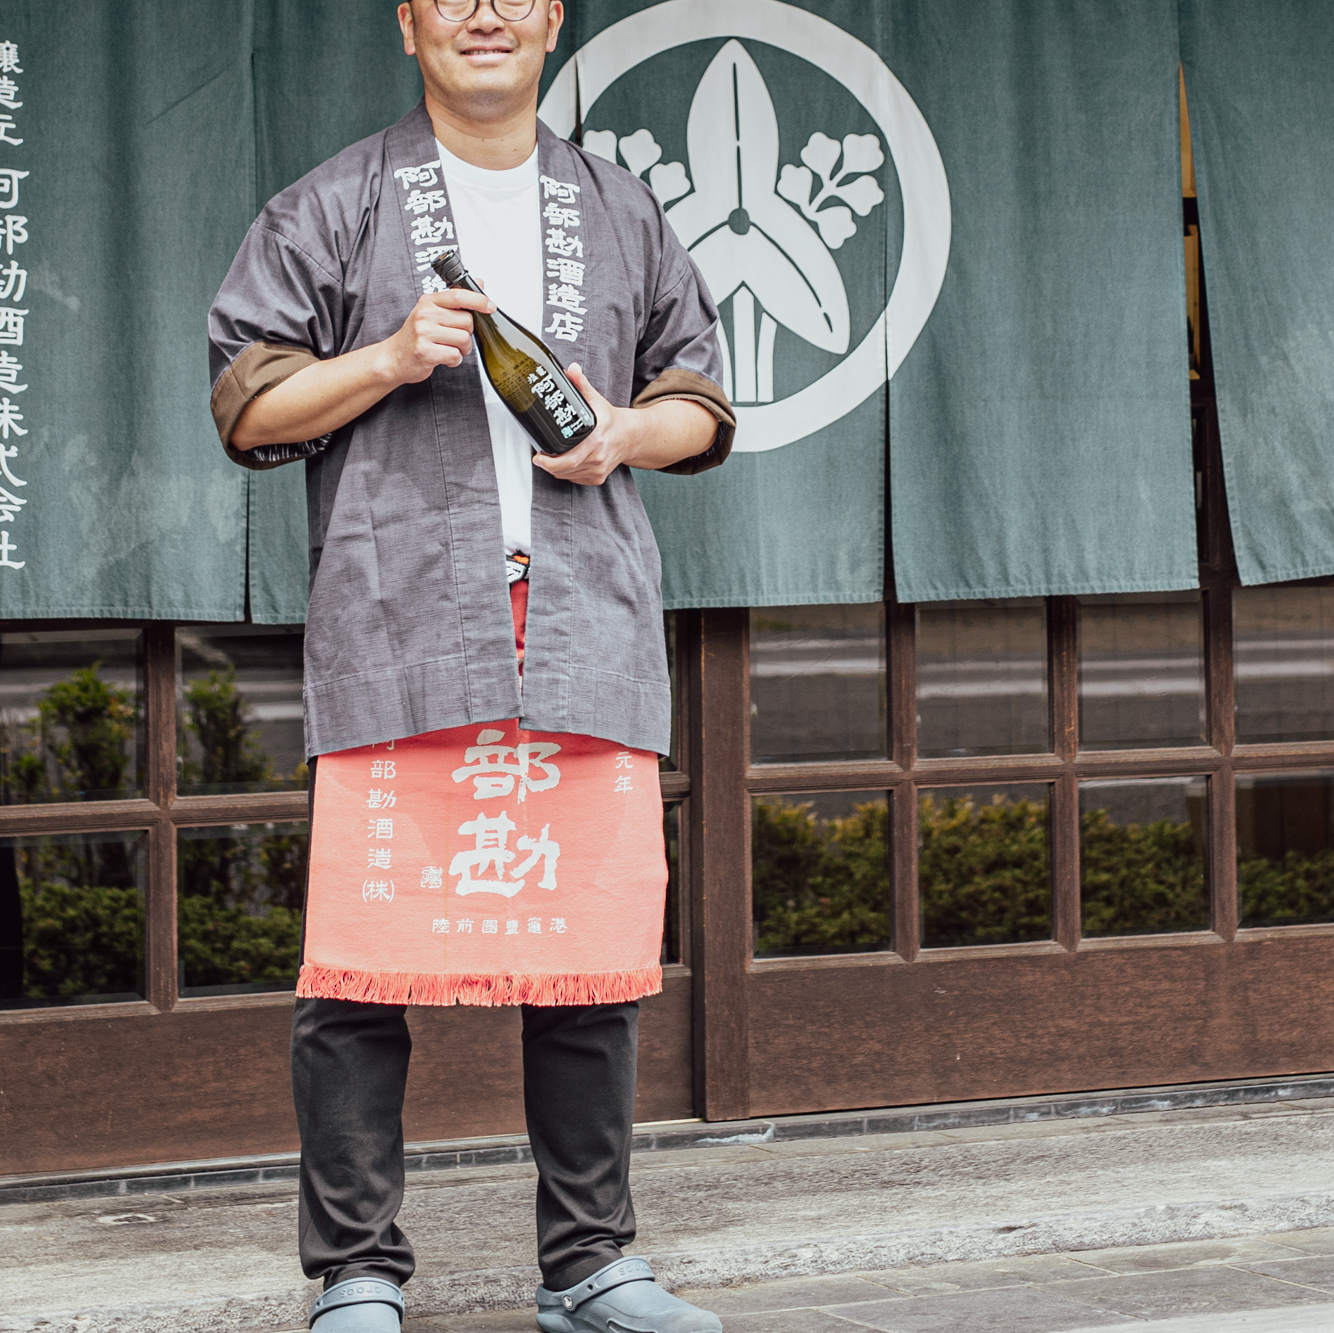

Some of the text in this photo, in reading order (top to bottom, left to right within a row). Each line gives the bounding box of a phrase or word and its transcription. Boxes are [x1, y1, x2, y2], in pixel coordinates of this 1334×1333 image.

[539, 174, 588, 342] 阿部勘酒造店
[531, 372, 577, 427] 阿部勘
[614, 751, 634, 794] 元年
